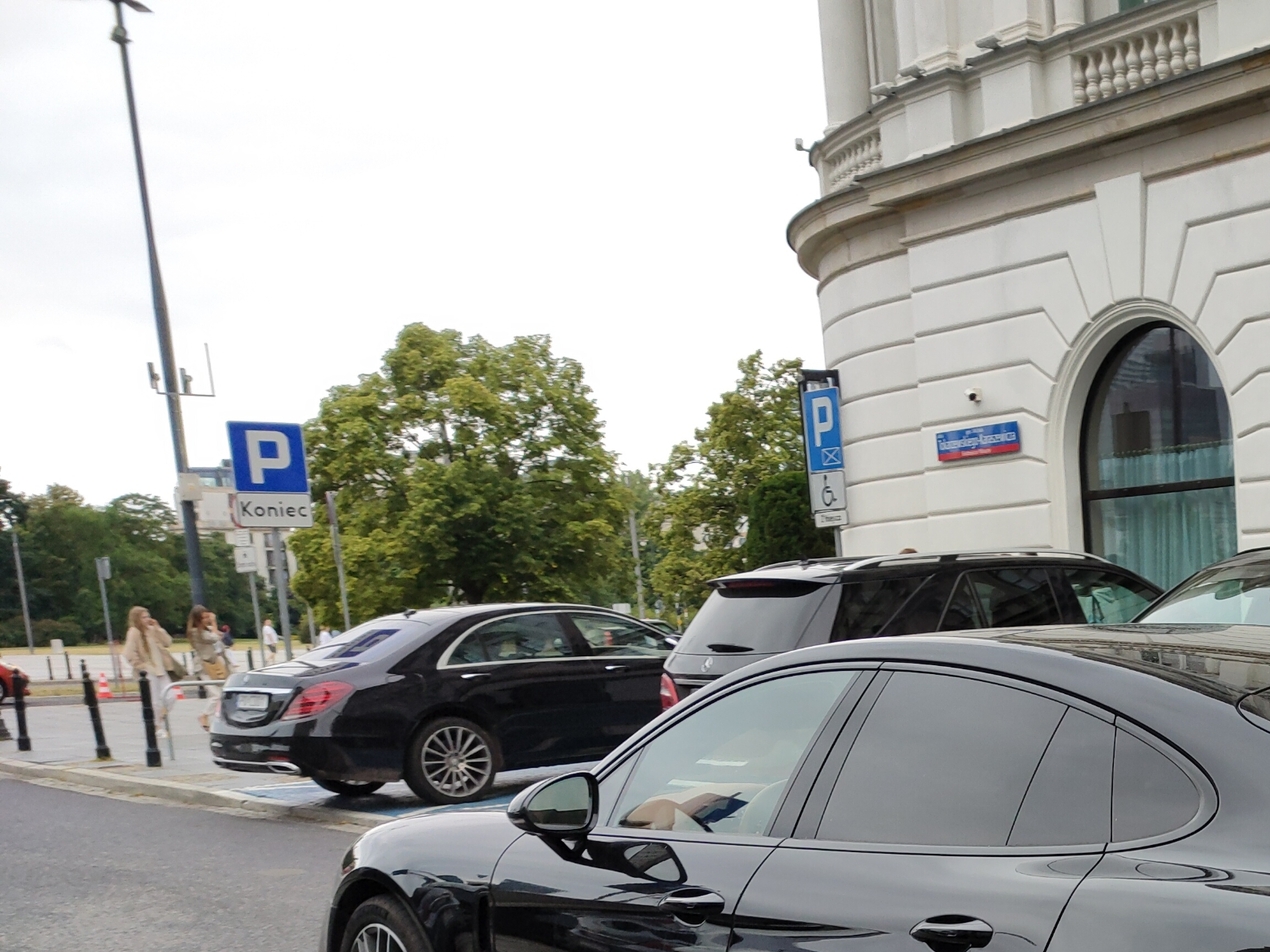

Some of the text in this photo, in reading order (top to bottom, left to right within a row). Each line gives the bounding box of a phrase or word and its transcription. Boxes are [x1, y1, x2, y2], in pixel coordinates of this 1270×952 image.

[812, 396, 834, 447] P
[245, 430, 291, 484] P
[240, 501, 308, 518] Koniec
